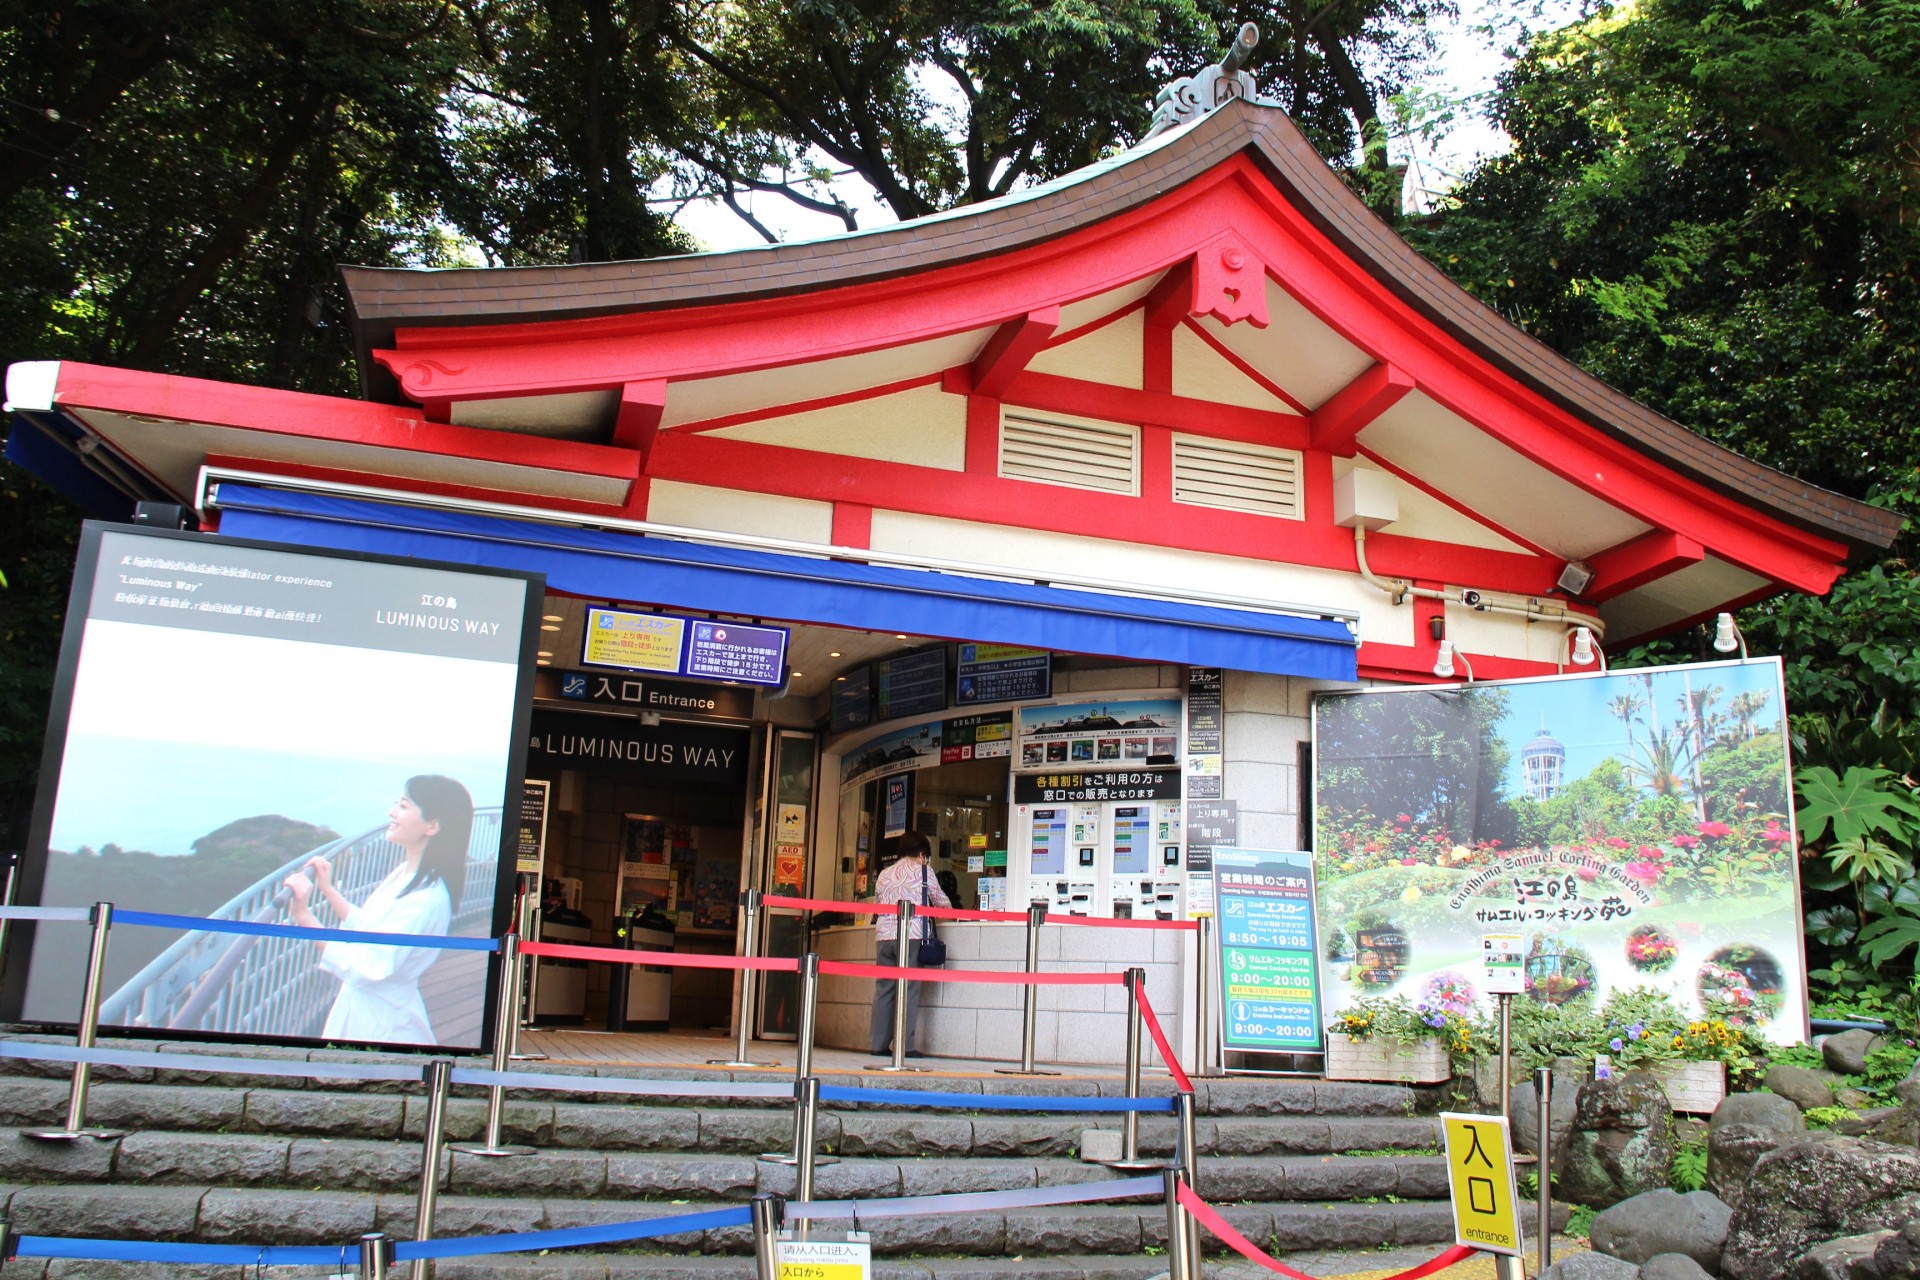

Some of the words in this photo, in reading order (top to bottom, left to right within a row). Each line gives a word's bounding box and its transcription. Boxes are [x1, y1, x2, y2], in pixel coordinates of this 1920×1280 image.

[274, 573, 333, 588] experience
[421, 594, 458, 610] 江の島
[376, 610, 460, 632] LUMINOUS
[465, 620, 500, 636] WAY
[622, 632, 651, 642] 上り専用
[594, 678, 643, 702] 入口
[650, 692, 716, 710] Entrance
[546, 734, 674, 764] LUMINOUS
[684, 746, 734, 768] WAY
[1036, 773, 1163, 788] 各種割引をご利用の方は
[1044, 788, 1155, 801] 窓口での販売となります
[1196, 810, 1228, 818] 上り専用
[1201, 828, 1222, 838] 階段
[1220, 872, 1307, 888] 営業時間のご案内
[1503, 851, 1554, 870] Samuel
[1609, 865, 1650, 905] Garden
[1514, 874, 1578, 905] 江の島
[1265, 902, 1306, 913] エスカー
[1269, 1006, 1310, 1015] シーキャンドル
[1463, 1124, 1496, 1215] 入口
[1466, 1228, 1509, 1244] entrance
[784, 1244, 858, 1256] 请从入口进入。
[783, 1266, 824, 1278] 入口から
